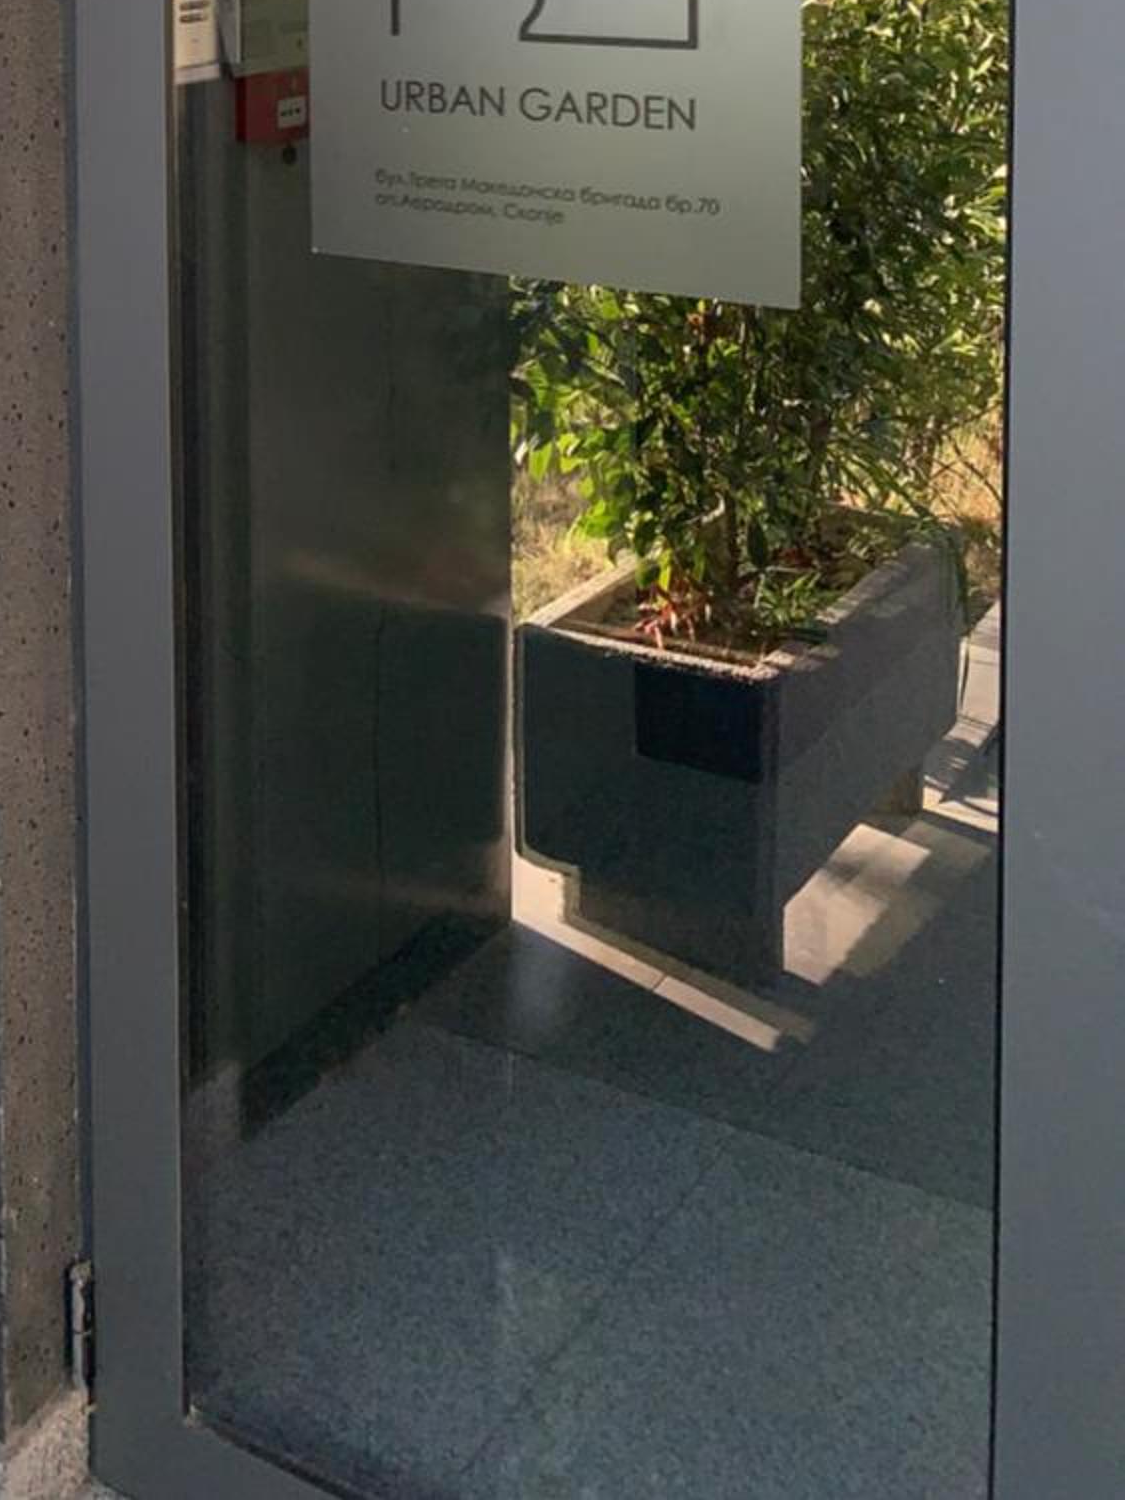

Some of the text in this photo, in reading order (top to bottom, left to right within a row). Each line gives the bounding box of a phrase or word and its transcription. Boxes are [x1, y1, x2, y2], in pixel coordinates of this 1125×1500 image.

[380, 79, 696, 131] URBAN GARDEN
[503, 203, 565, 225] Скопје
[579, 186, 661, 211] бригада
[665, 195, 721, 217] бр.70
